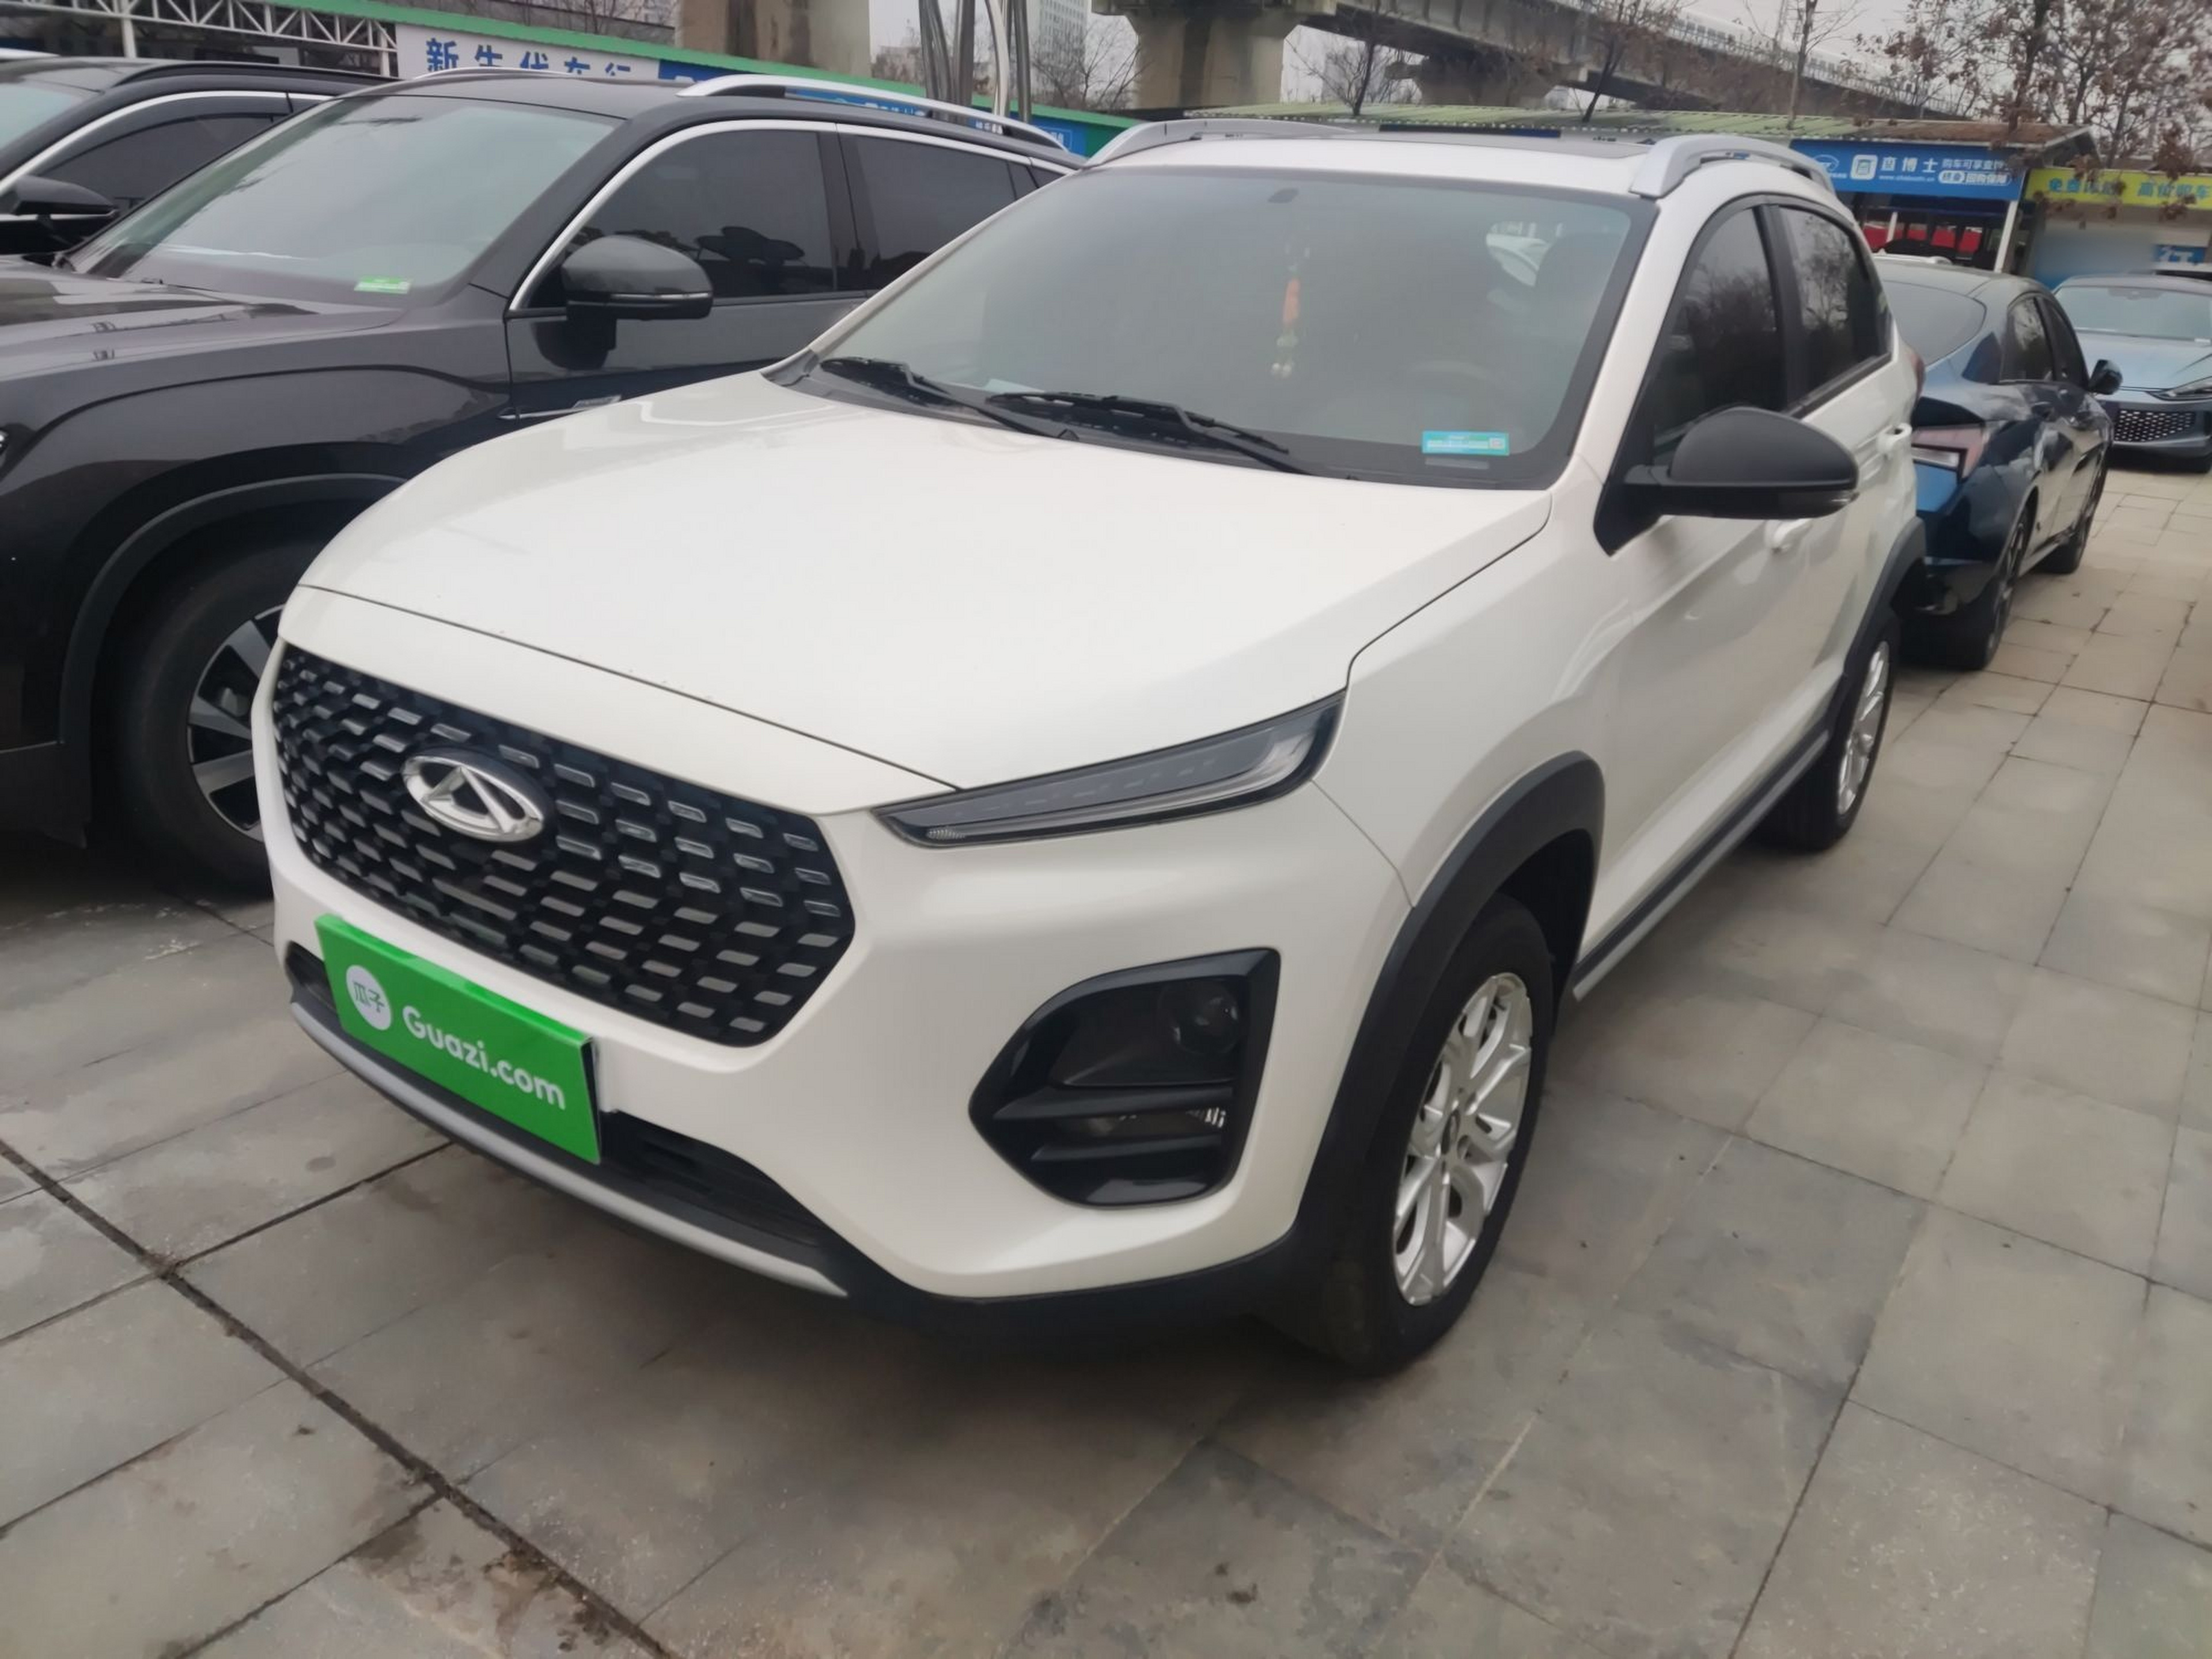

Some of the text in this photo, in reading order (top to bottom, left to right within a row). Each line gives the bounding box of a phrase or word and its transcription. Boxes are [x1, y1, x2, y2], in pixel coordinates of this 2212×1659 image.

[1880, 156, 1938, 173] 查博士
[353, 982, 386, 1014] 瓜子
[402, 1006, 566, 1111] Guazi.com
